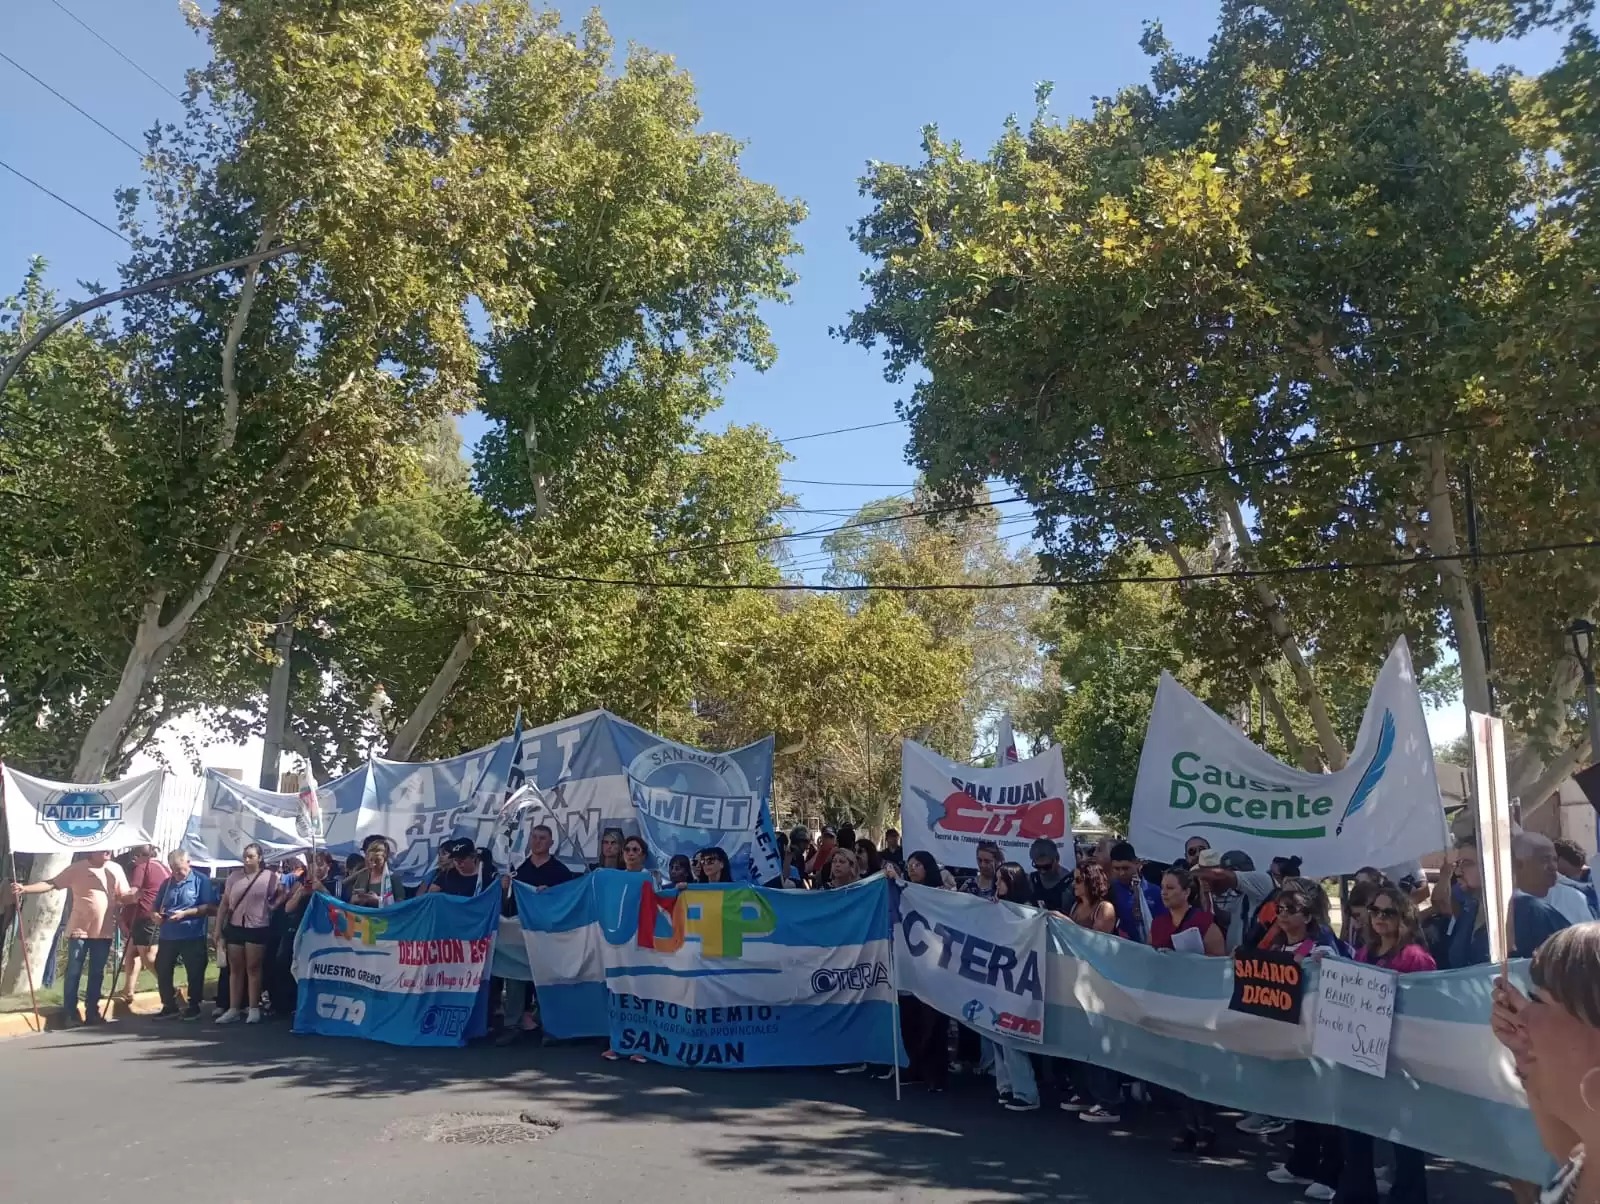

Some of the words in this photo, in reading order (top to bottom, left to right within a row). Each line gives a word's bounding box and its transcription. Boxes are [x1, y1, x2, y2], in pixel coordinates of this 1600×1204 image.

[652, 749, 684, 766] SAN
[688, 753, 731, 776] JUAN
[1172, 751, 1293, 793] Causa
[632, 781, 748, 827] AMET
[951, 776, 993, 804] SAN
[997, 778, 1048, 805] JUAN
[1169, 779, 1333, 820] Docente
[45, 805, 120, 819] AMET
[596, 870, 777, 959] UDAP
[313, 963, 357, 979] NUESTRO
[902, 910, 1044, 1002] CTERA
[1235, 959, 1299, 986] SALARIO
[811, 961, 892, 994] CTERA
[316, 992, 366, 1025] CTA
[611, 993, 679, 1020] ESTRO
[685, 1005, 781, 1025] GREMIO.
[1241, 984, 1293, 1011] DIGNO
[420, 1004, 471, 1037] CTER
[710, 1023, 778, 1038] PROVINCIALES
[619, 1028, 670, 1057] SAN
[675, 1041, 745, 1066] JUAN
